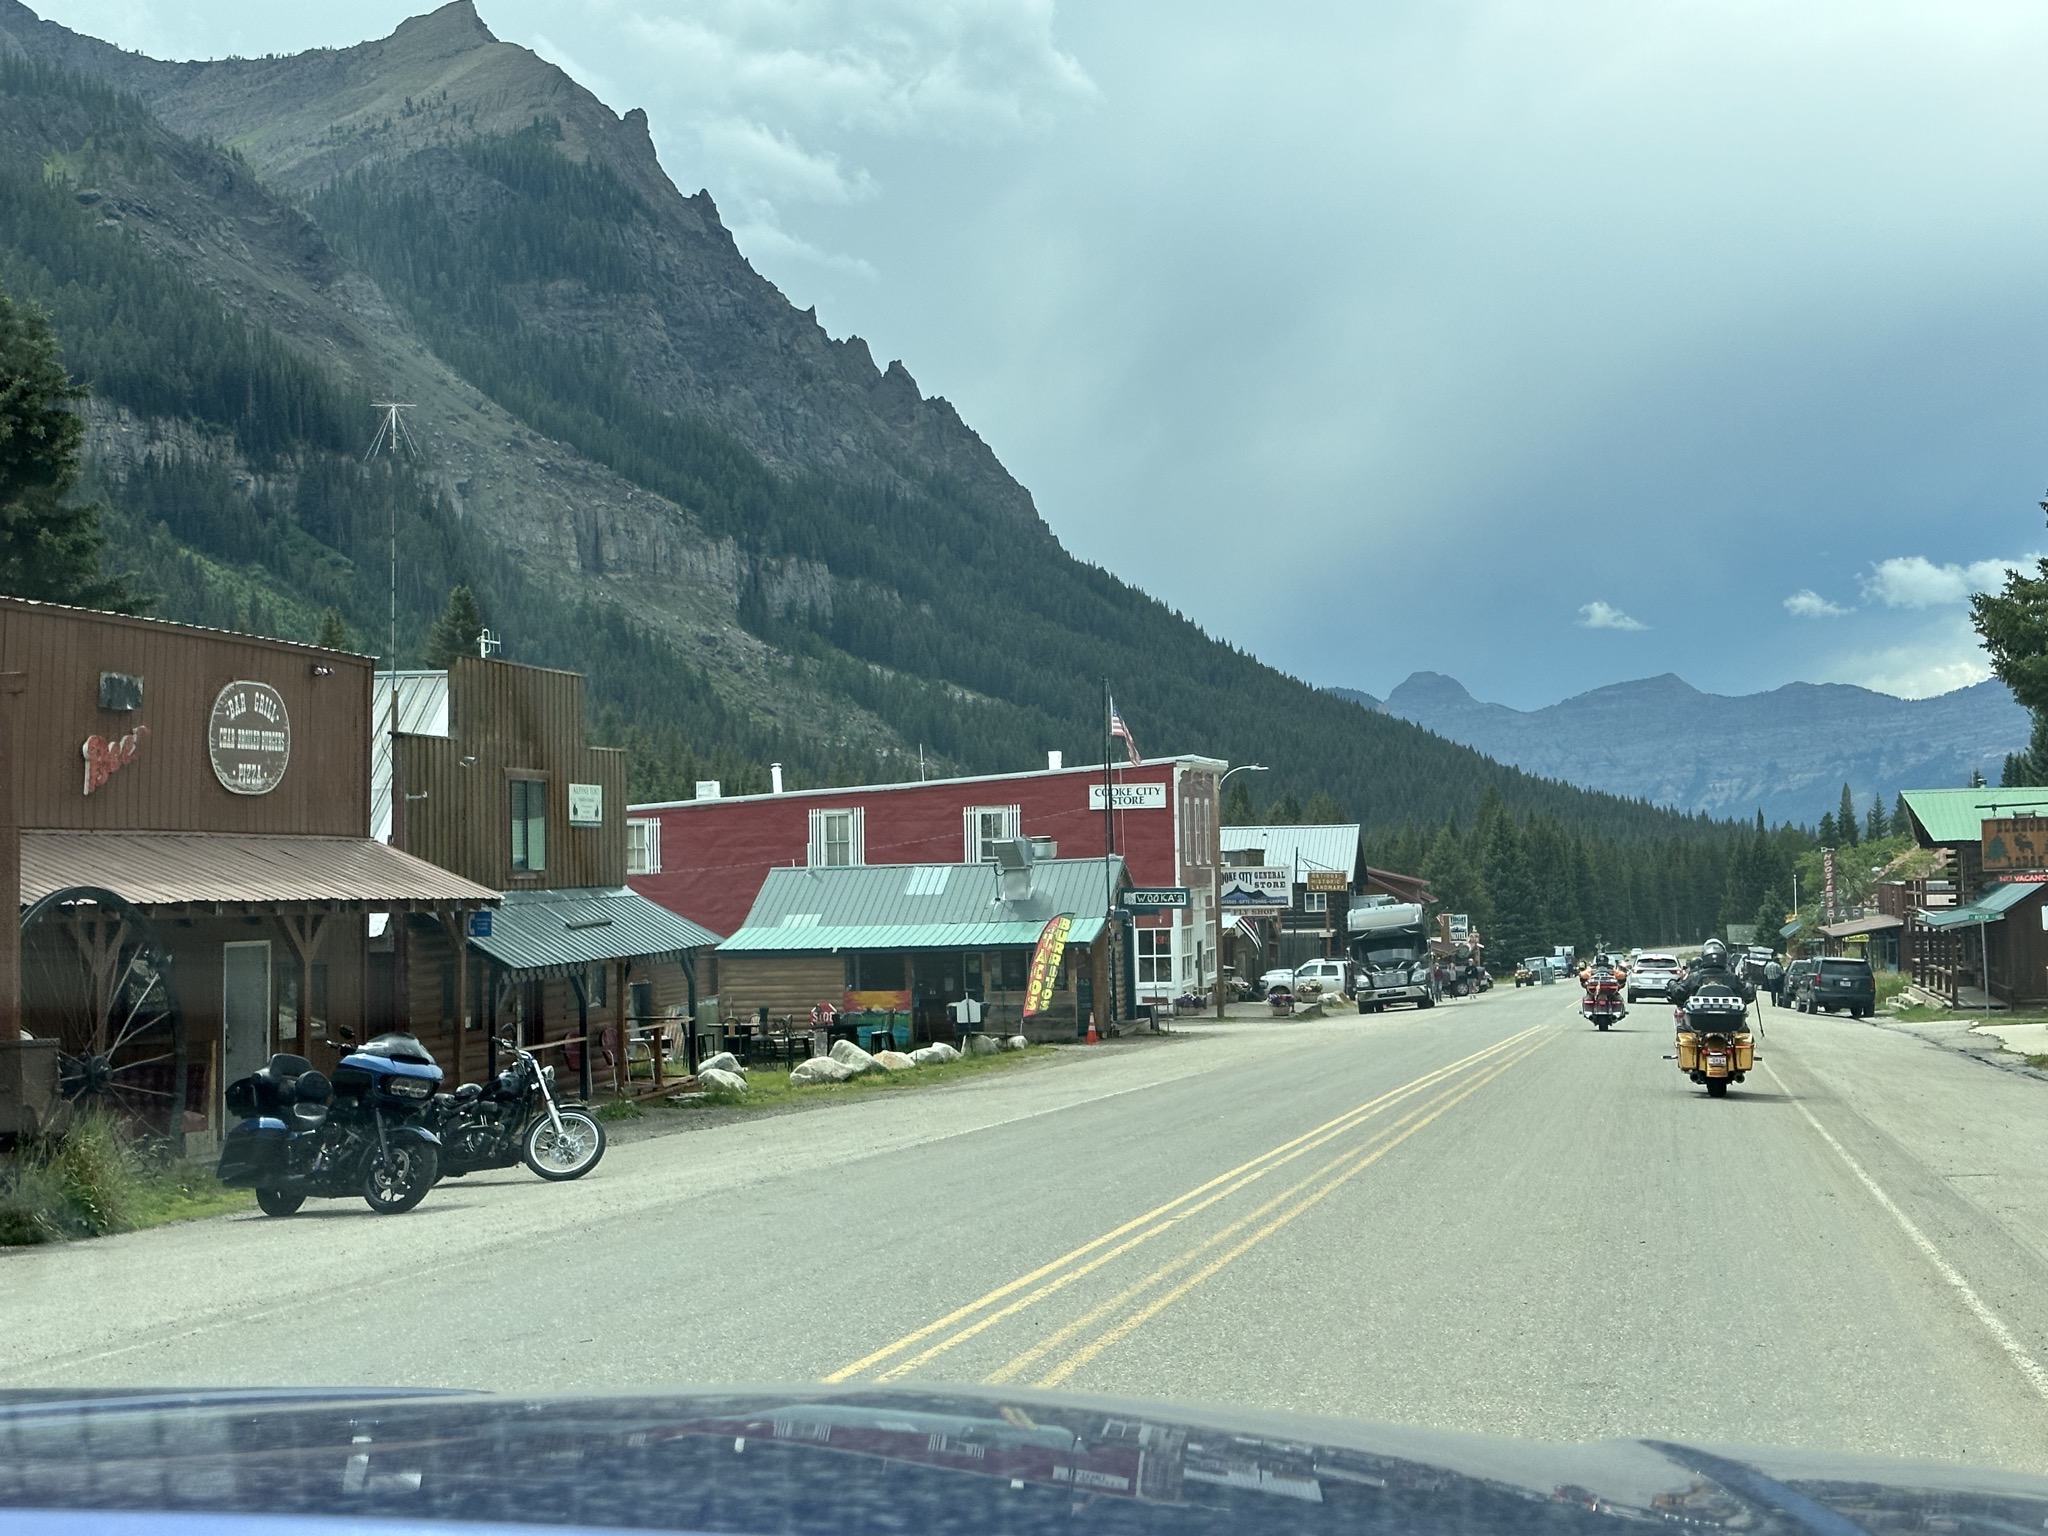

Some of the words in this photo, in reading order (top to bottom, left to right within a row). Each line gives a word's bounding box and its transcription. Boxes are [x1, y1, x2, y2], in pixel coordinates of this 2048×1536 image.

[228, 692, 247, 720] BAR
[254, 691, 277, 724] GRILL
[238, 762, 262, 785] PIZZA
[1094, 787, 1132, 798] COOKE
[1136, 786, 1161, 796] CITY
[1111, 795, 1145, 805] STORE
[1239, 871, 1253, 885] CITY
[1254, 871, 1286, 880] GENERAL
[2014, 874, 2048, 882] VACANC
[1254, 881, 1286, 889] STORE
[1136, 894, 1184, 903] WOOKA'S
[1826, 908, 1862, 919] BAR
[1038, 917, 1071, 1012] BURRITOS
[1025, 932, 1054, 1012] TACOS
